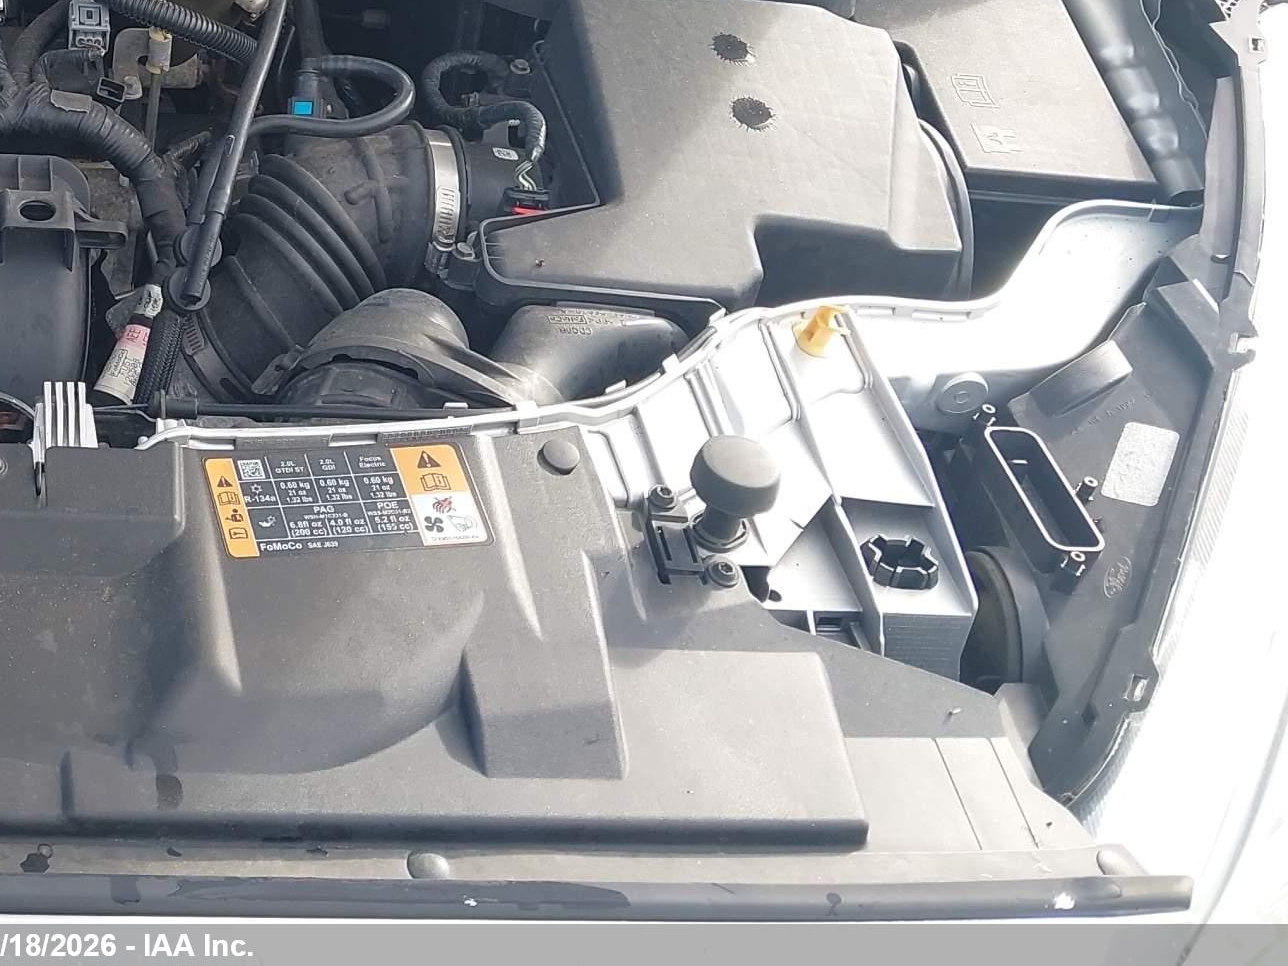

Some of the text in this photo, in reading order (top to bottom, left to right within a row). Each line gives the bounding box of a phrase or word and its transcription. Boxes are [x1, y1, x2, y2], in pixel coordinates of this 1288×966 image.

[319, 478, 350, 487] 0.60 kg
[382, 476, 394, 485] kg
[299, 482, 311, 490] kg
[244, 495, 276, 503] R-134a
[313, 505, 335, 513] PAG
[377, 501, 399, 509] POE
[374, 516, 390, 524] 5.2
[398, 515, 411, 523] oz
[333, 525, 369, 535] (120 cc)
[399, 522, 414, 531] cc)
[292, 528, 327, 537] (200 cc)
[260, 542, 303, 551] FoMoCo
